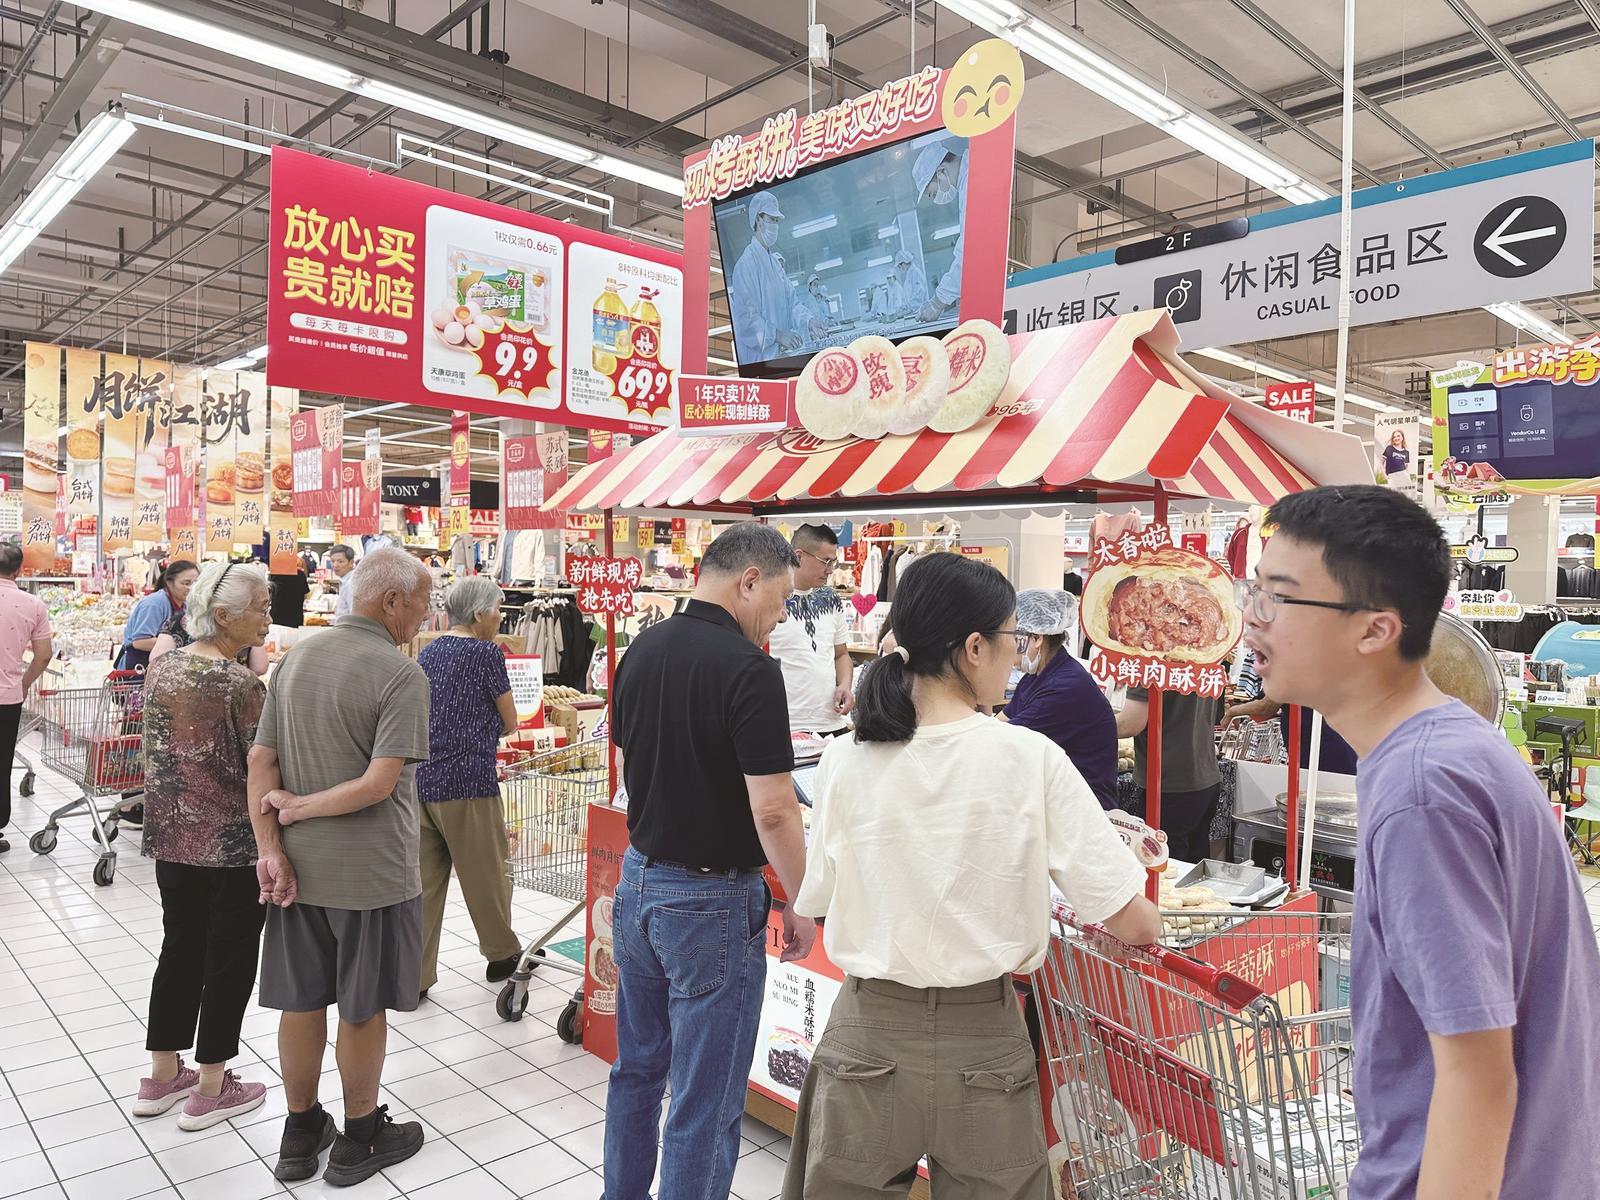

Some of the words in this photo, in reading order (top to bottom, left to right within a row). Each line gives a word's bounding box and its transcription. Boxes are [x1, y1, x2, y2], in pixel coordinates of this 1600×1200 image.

[282, 203, 417, 274] 放心买
[1220, 220, 1449, 301] 休闲食品区
[282, 255, 416, 320] 贵就赔
[1256, 293, 1331, 321] CASUAL
[1350, 284, 1400, 305] OOD
[304, 315, 396, 342] 每天每卡限购
[495, 341, 538, 379] 9.9
[1495, 343, 1600, 382] 出游季
[618, 365, 668, 402] 69.9
[694, 384, 760, 404] 1年只卖1次
[1268, 388, 1312, 406] SALE
[84, 371, 251, 451] 月饼江湖
[684, 403, 771, 421] 匠心制作现制鲜酥
[71, 478, 92, 491] 台式
[387, 484, 420, 497] TONY
[70, 491, 94, 505] 月饼
[241, 502, 259, 513] 京式
[28, 518, 52, 534] 苏式
[111, 516, 130, 527] 新疆
[138, 514, 160, 527] 月饼
[239, 512, 260, 526] 月饼
[26, 532, 51, 546] 月饼
[107, 527, 130, 541] 月饼
[176, 529, 195, 541] 广式
[211, 527, 231, 542] 月饼
[175, 541, 195, 555] 月饼
[275, 541, 294, 555] 月饼
[1095, 526, 1172, 567] 太香啦
[568, 560, 642, 586] 新鲜现烤
[581, 586, 633, 613] 抢先吃
[1461, 593, 1495, 604] 奔赴你
[1091, 655, 1226, 696] 小鲜肉酥饼
[786, 973, 799, 984] XUE
[789, 985, 799, 996] MI
[782, 993, 799, 1008] BING
[803, 977, 816, 1043] 血糯米酥饼
